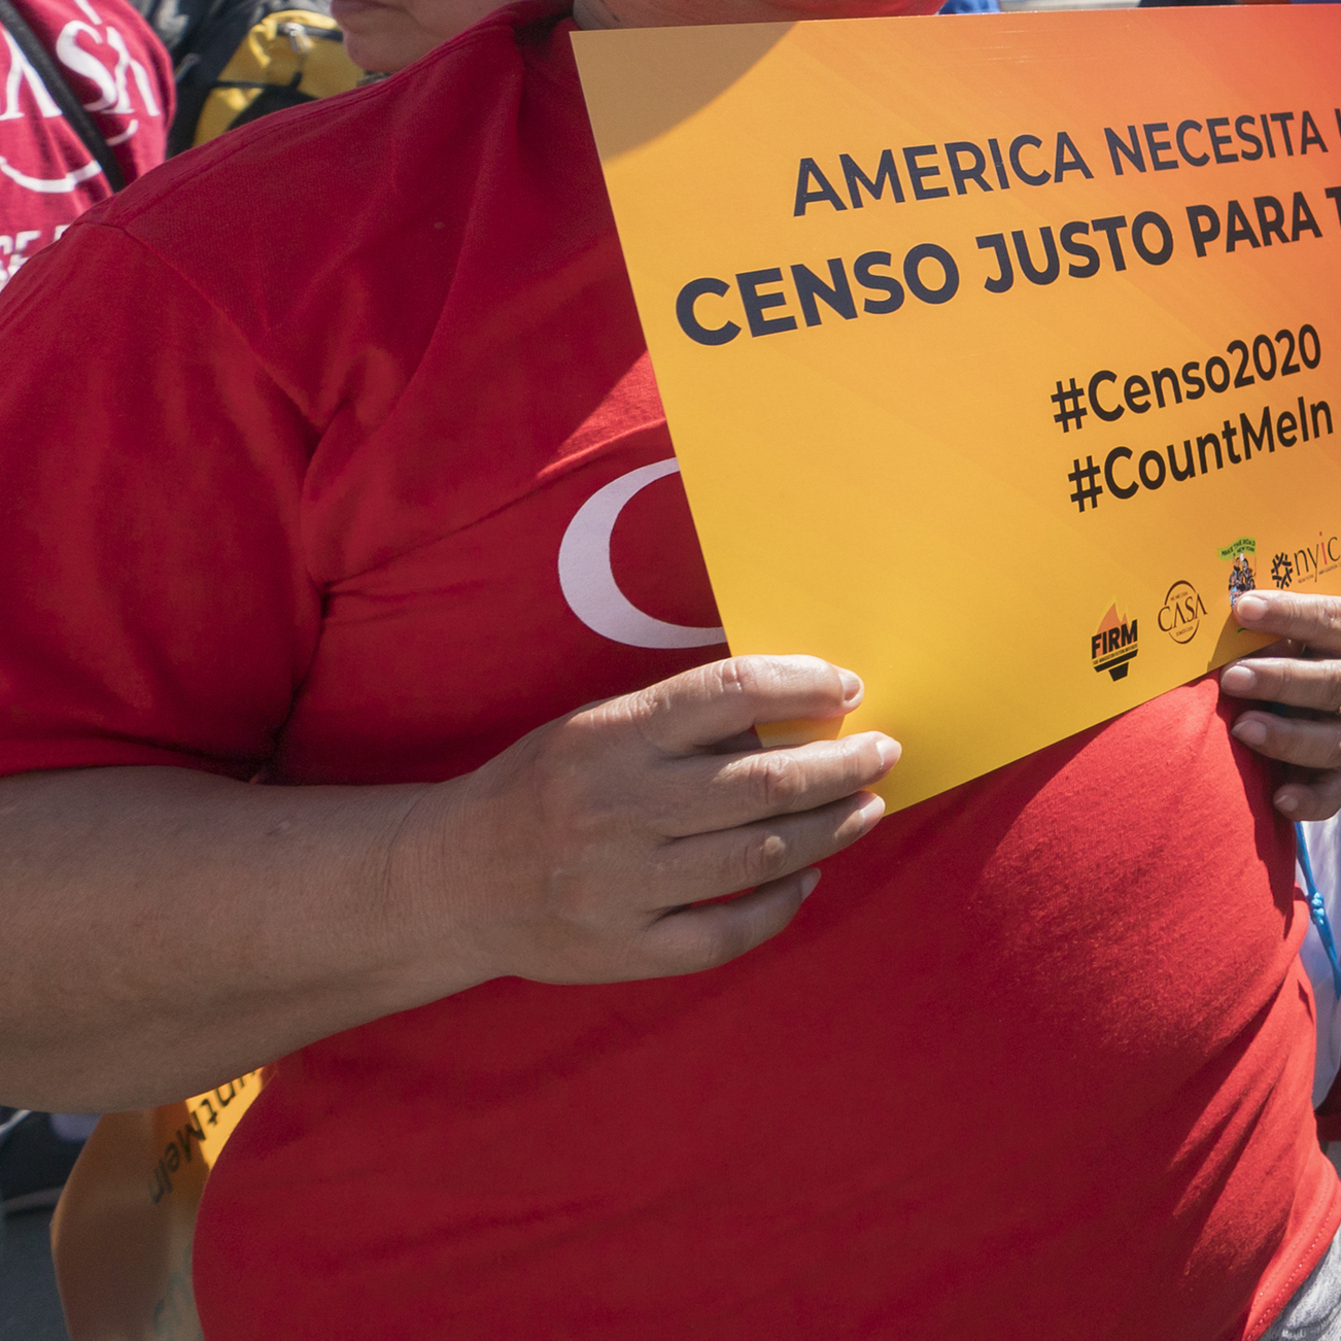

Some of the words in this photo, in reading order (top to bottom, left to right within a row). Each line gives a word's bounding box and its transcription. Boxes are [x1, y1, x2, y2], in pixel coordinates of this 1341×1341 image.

[793, 131, 1093, 217] AMERICA
[1104, 109, 1328, 176] NECESITA
[674, 242, 961, 347] CENSO
[975, 210, 1175, 294] JUSTO
[1185, 194, 1324, 259] PARA
[1050, 323, 1323, 434] #Censo2020
[1067, 395, 1335, 513] #CountMeIn
[1294, 531, 1341, 583] nyic
[1091, 619, 1138, 660] FIRM
[1157, 593, 1209, 632] CASA
